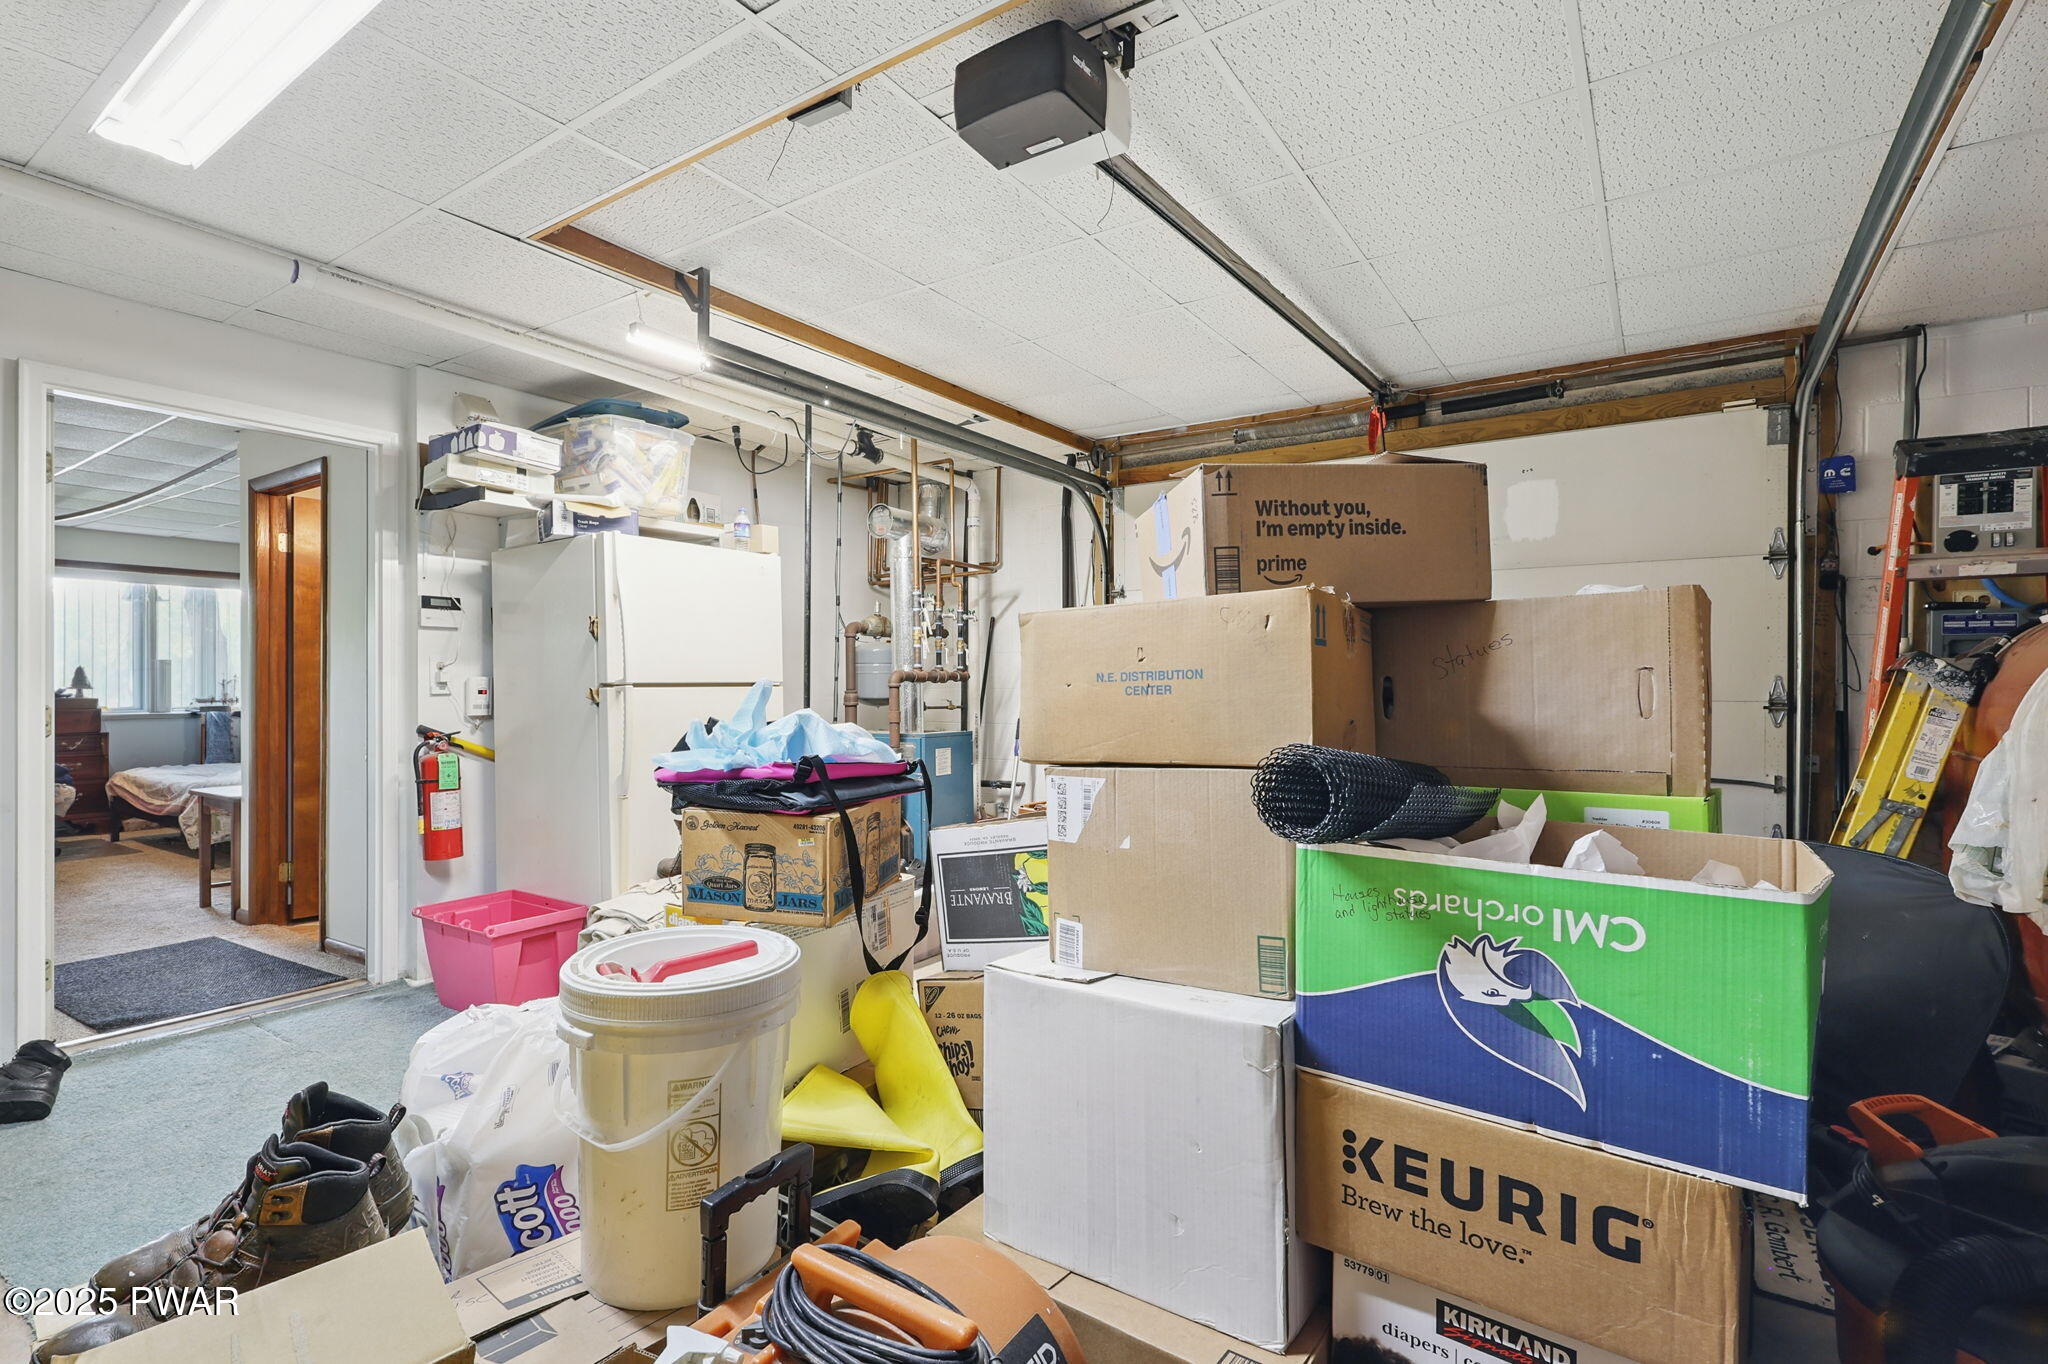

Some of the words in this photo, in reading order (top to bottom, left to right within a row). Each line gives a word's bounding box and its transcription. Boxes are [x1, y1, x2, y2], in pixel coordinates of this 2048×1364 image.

[1255, 500, 1331, 517] Without
[1330, 501, 1371, 518] you,
[1256, 521, 1283, 537] I'm
[1287, 522, 1345, 539] empty
[1349, 518, 1407, 535] inside.
[1256, 555, 1307, 575] prime
[1431, 633, 1514, 681] Statues
[1096, 672, 1117, 683] N.E.
[1120, 668, 1204, 683] DISTRIBUTION
[1124, 684, 1172, 697] CENTER
[700, 820, 726, 830] Golden
[727, 822, 760, 831] Harvest
[706, 881, 725, 889] Quart
[1331, 884, 1380, 904] Houses
[690, 886, 742, 903] MASON
[778, 894, 818, 909] JARS
[950, 890, 1013, 906] BRAVANTE
[1335, 904, 1356, 919] and
[1394, 887, 1544, 931] orchards
[1553, 908, 1646, 953] CMI
[680, 1080, 710, 1090] WARNI
[1342, 1128, 1642, 1265] KEURIG
[496, 1184, 552, 1249] cott
[553, 1194, 580, 1235] 000
[1341, 1186, 1404, 1223] Brew
[1409, 1203, 1452, 1239] the
[1764, 1222, 1805, 1283] Gombert
[528, 1279, 576, 1299] FRAGILE
[1382, 1321, 1449, 1359] diapers
[1443, 1305, 1571, 1364] KIRKLAND
